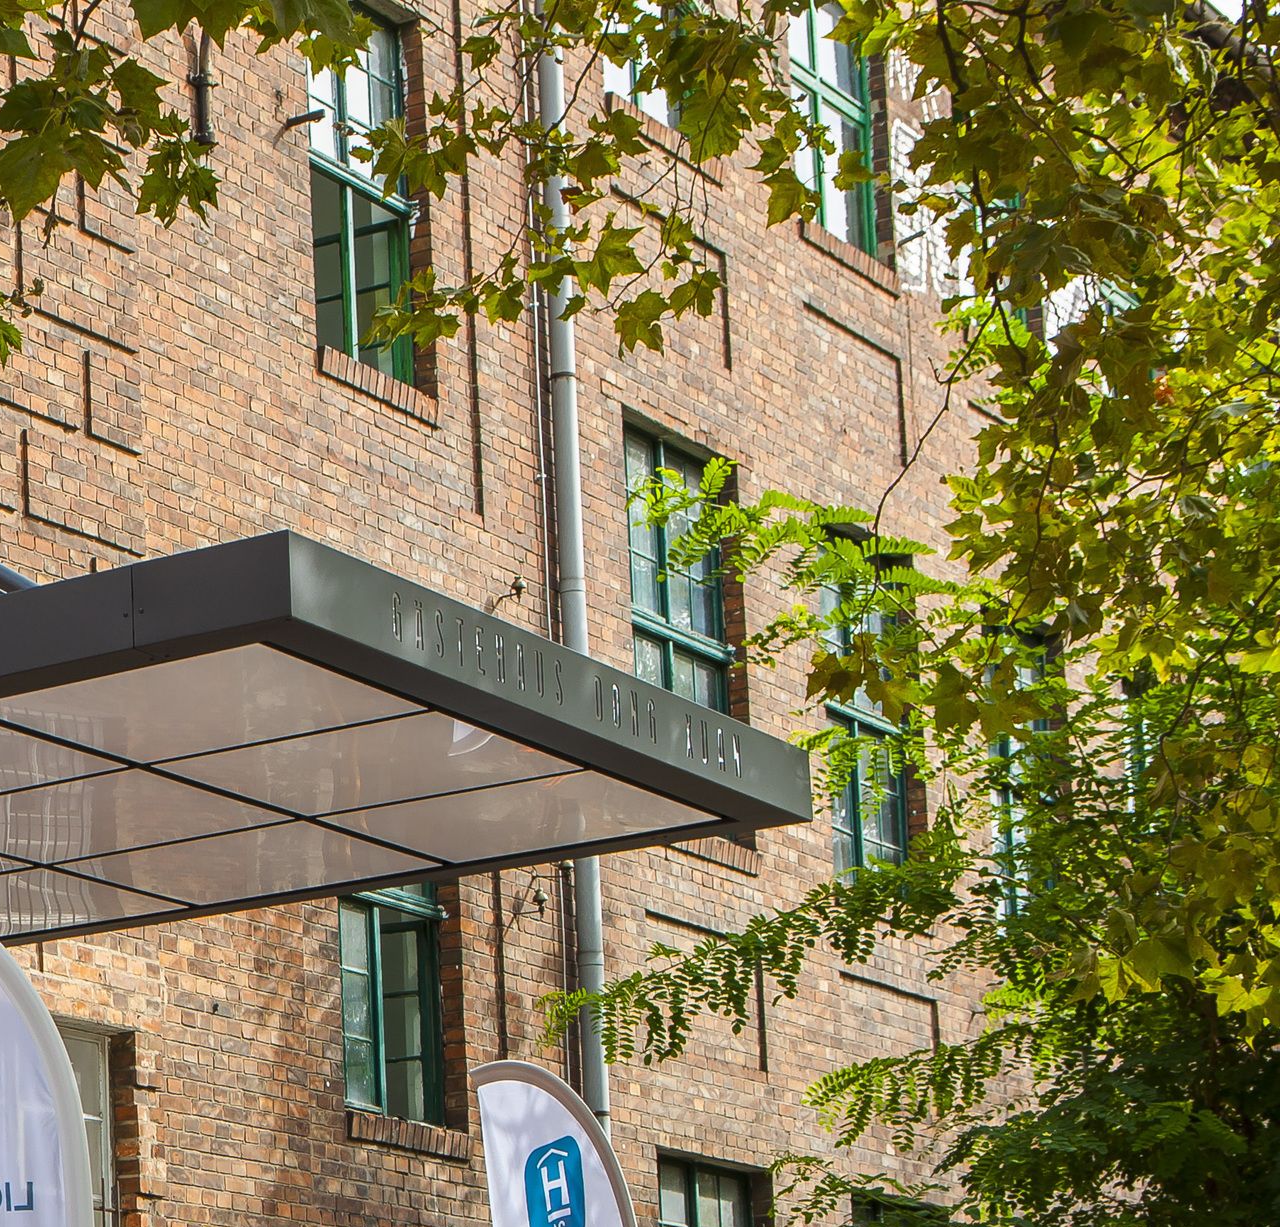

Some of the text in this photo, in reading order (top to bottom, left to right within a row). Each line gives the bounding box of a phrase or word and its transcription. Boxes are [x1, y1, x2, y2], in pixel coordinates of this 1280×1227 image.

[392, 591, 742, 779] GÄSTEHAUS DONG XUAN
